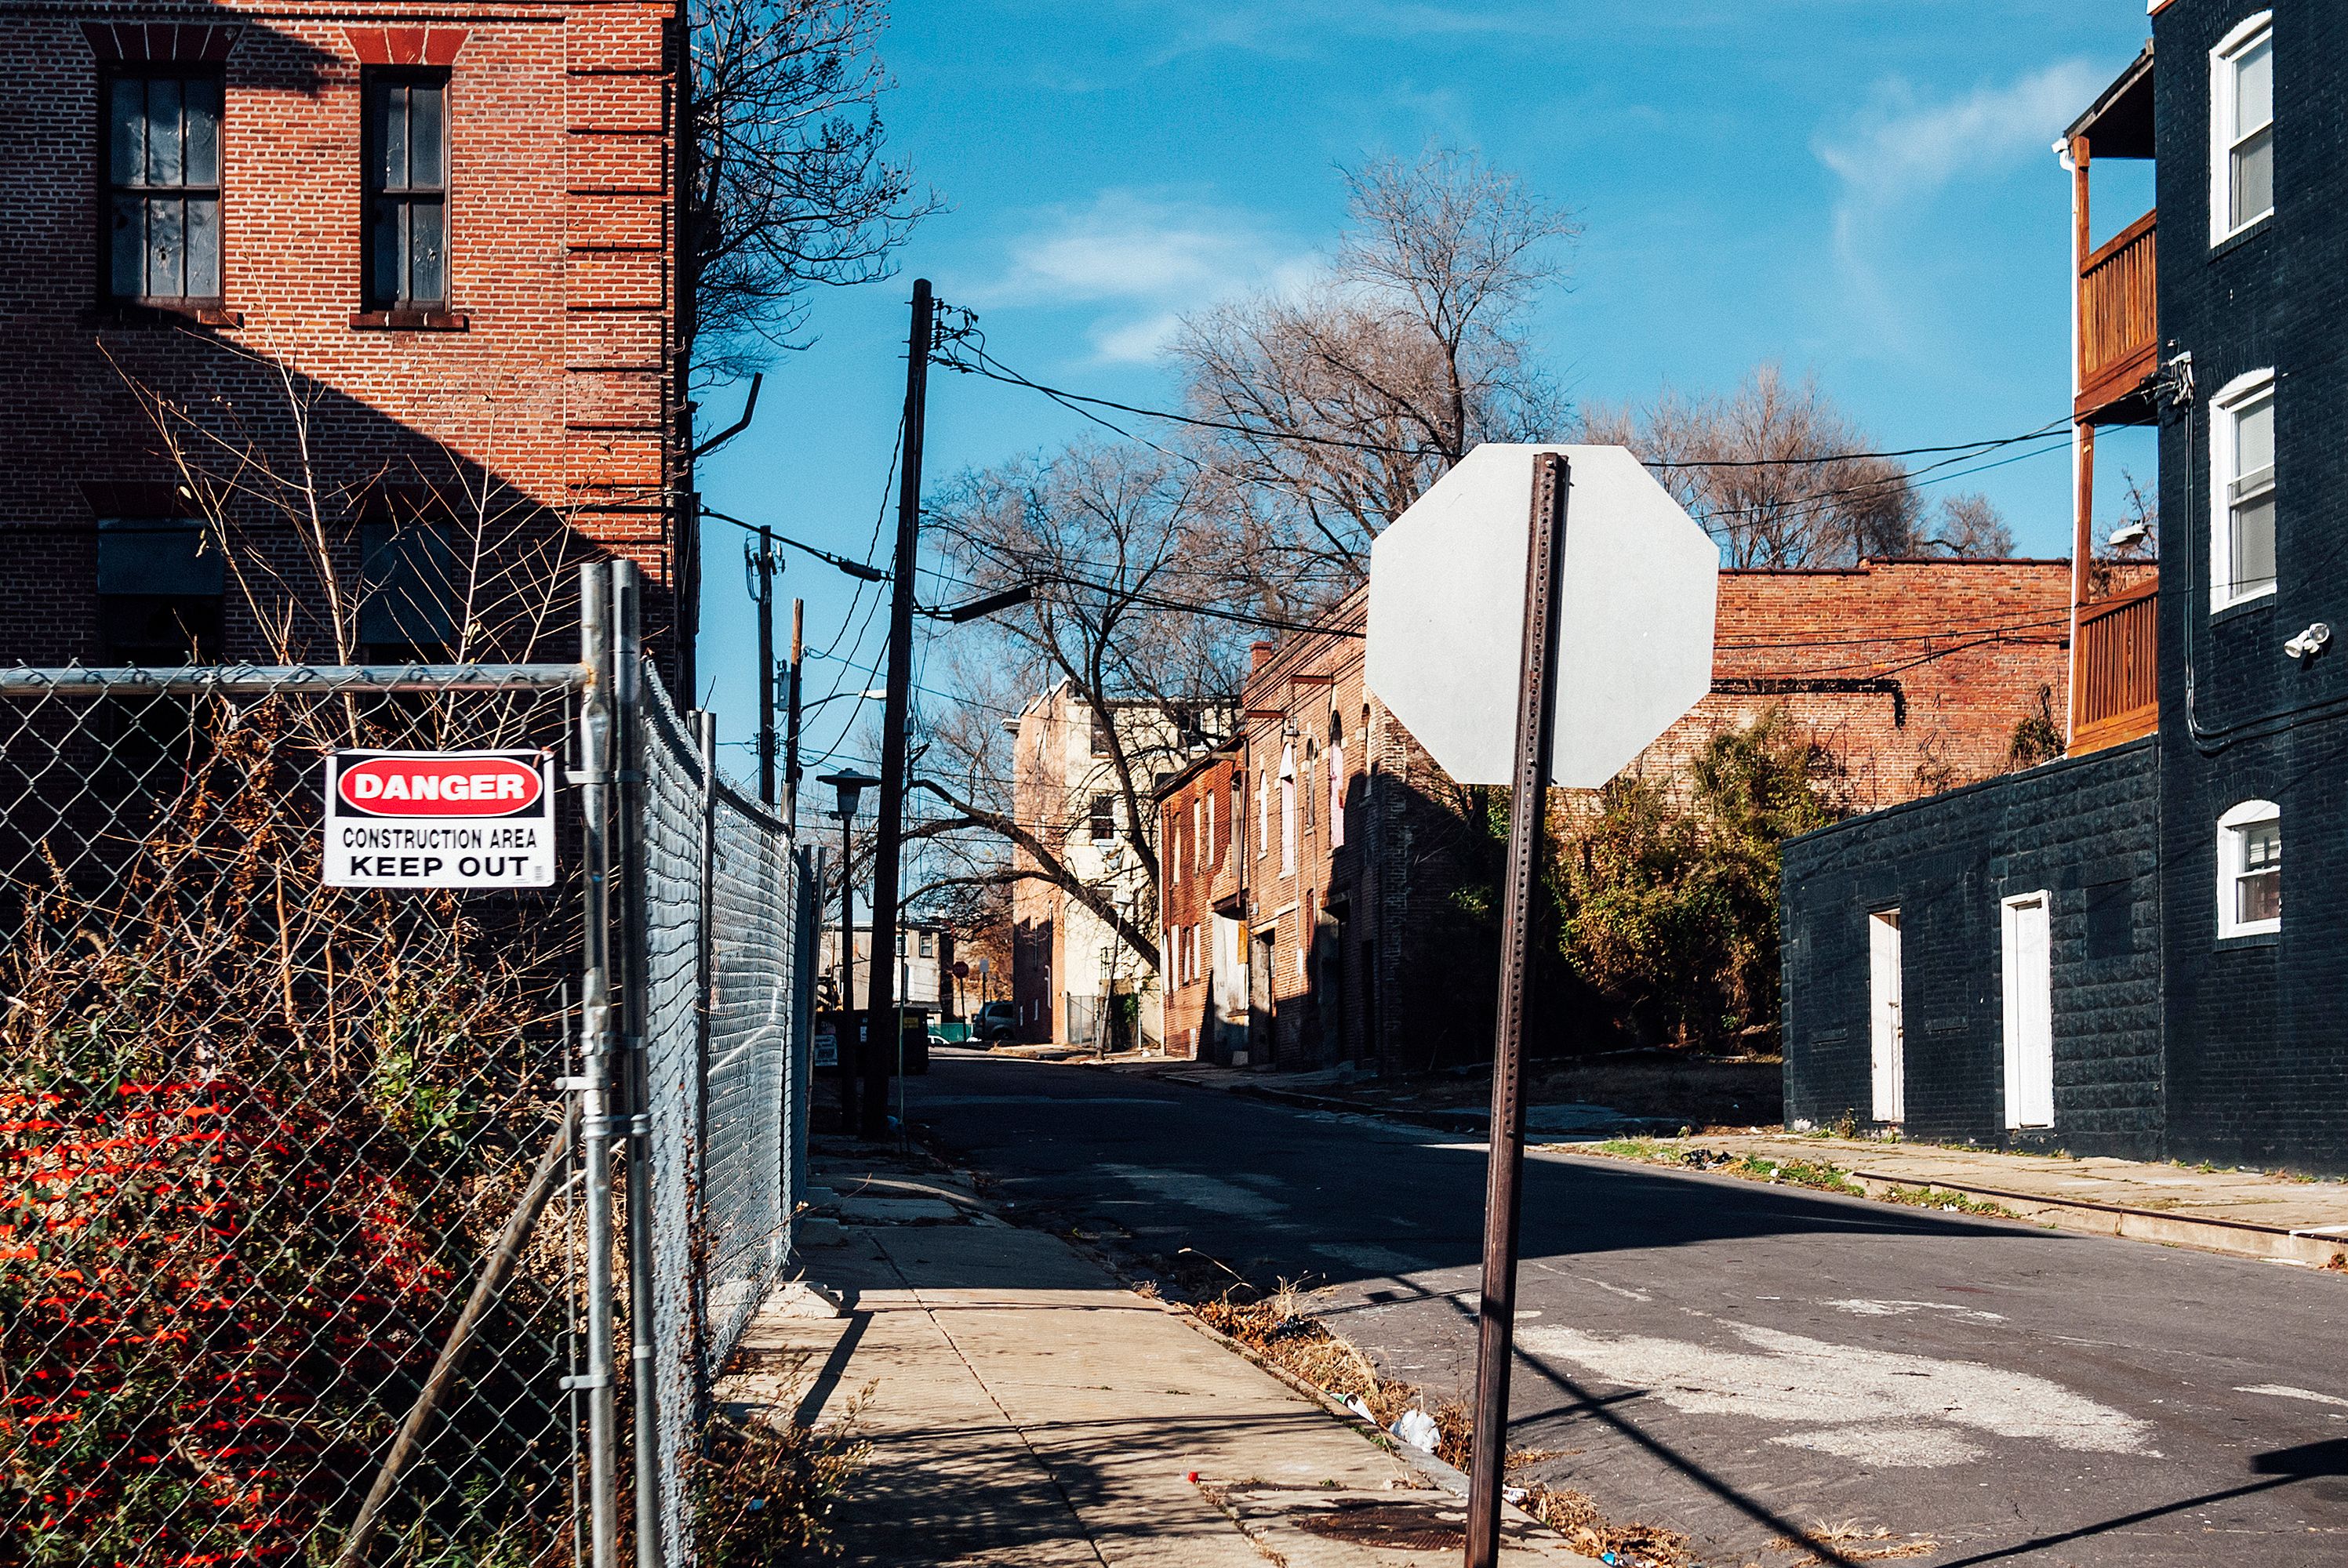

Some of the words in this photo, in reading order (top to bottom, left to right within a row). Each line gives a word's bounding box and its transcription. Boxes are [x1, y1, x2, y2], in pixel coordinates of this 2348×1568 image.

[355, 773, 525, 800] DANGER
[343, 827, 482, 849] CONSTRUCTION
[489, 828, 537, 849] AREA
[351, 856, 442, 877] KEEP
[459, 856, 529, 877] OUT
